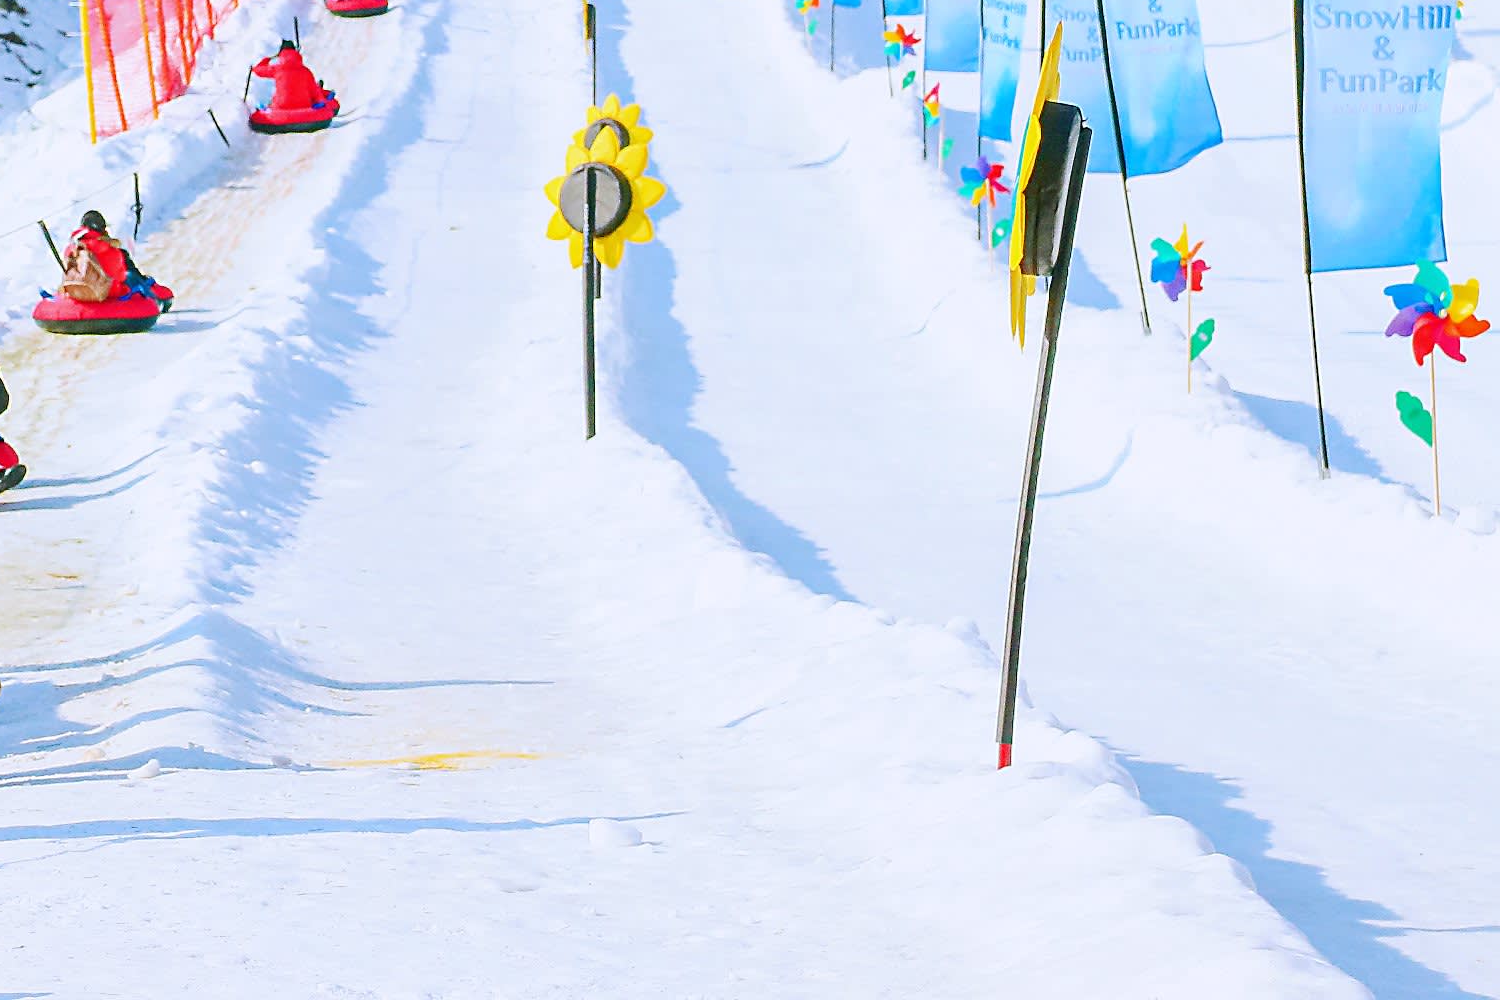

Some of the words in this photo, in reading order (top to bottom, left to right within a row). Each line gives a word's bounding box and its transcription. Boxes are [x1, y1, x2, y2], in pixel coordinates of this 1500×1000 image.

[1114, 17, 1200, 41] FunPark
[1313, 2, 1451, 30] SnowHill
[1372, 35, 1395, 61] &
[1318, 67, 1443, 94] FunPark
